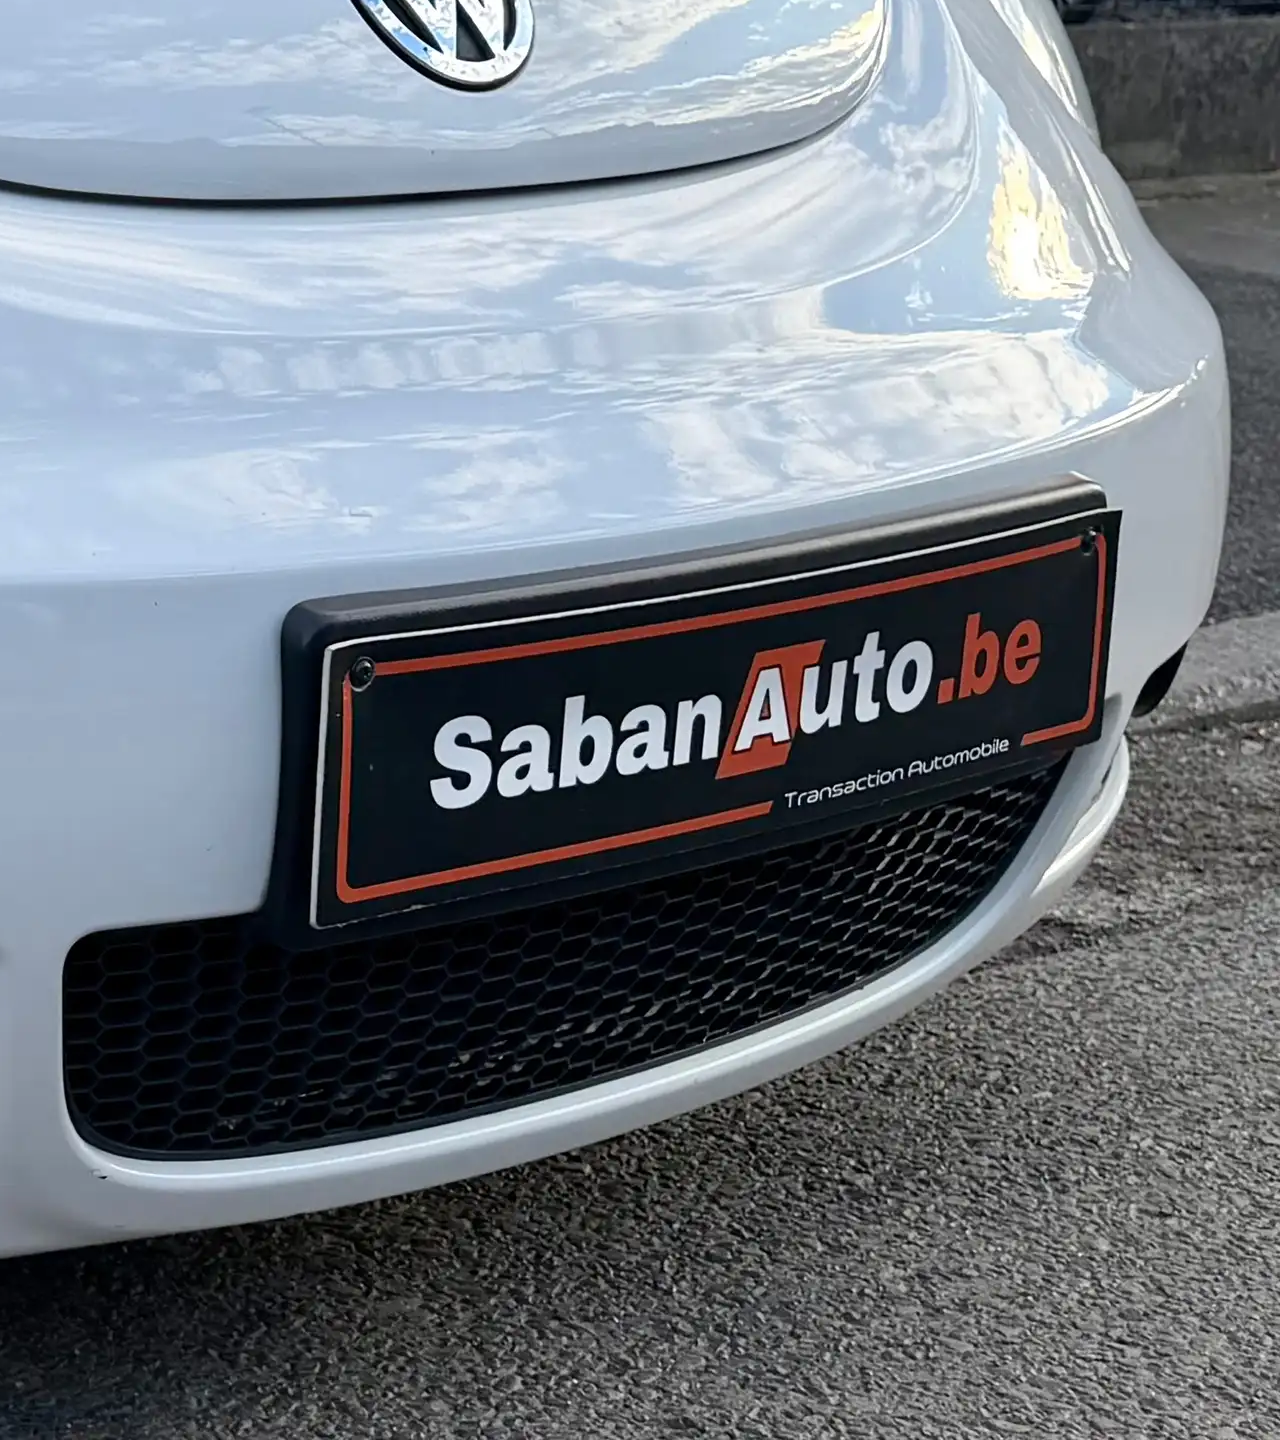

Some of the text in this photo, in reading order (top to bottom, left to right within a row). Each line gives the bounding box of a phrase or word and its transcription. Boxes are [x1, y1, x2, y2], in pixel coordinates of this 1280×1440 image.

[430, 612, 1042, 810] SabanAuto.be
[784, 737, 1010, 809] Transaction Automobile
